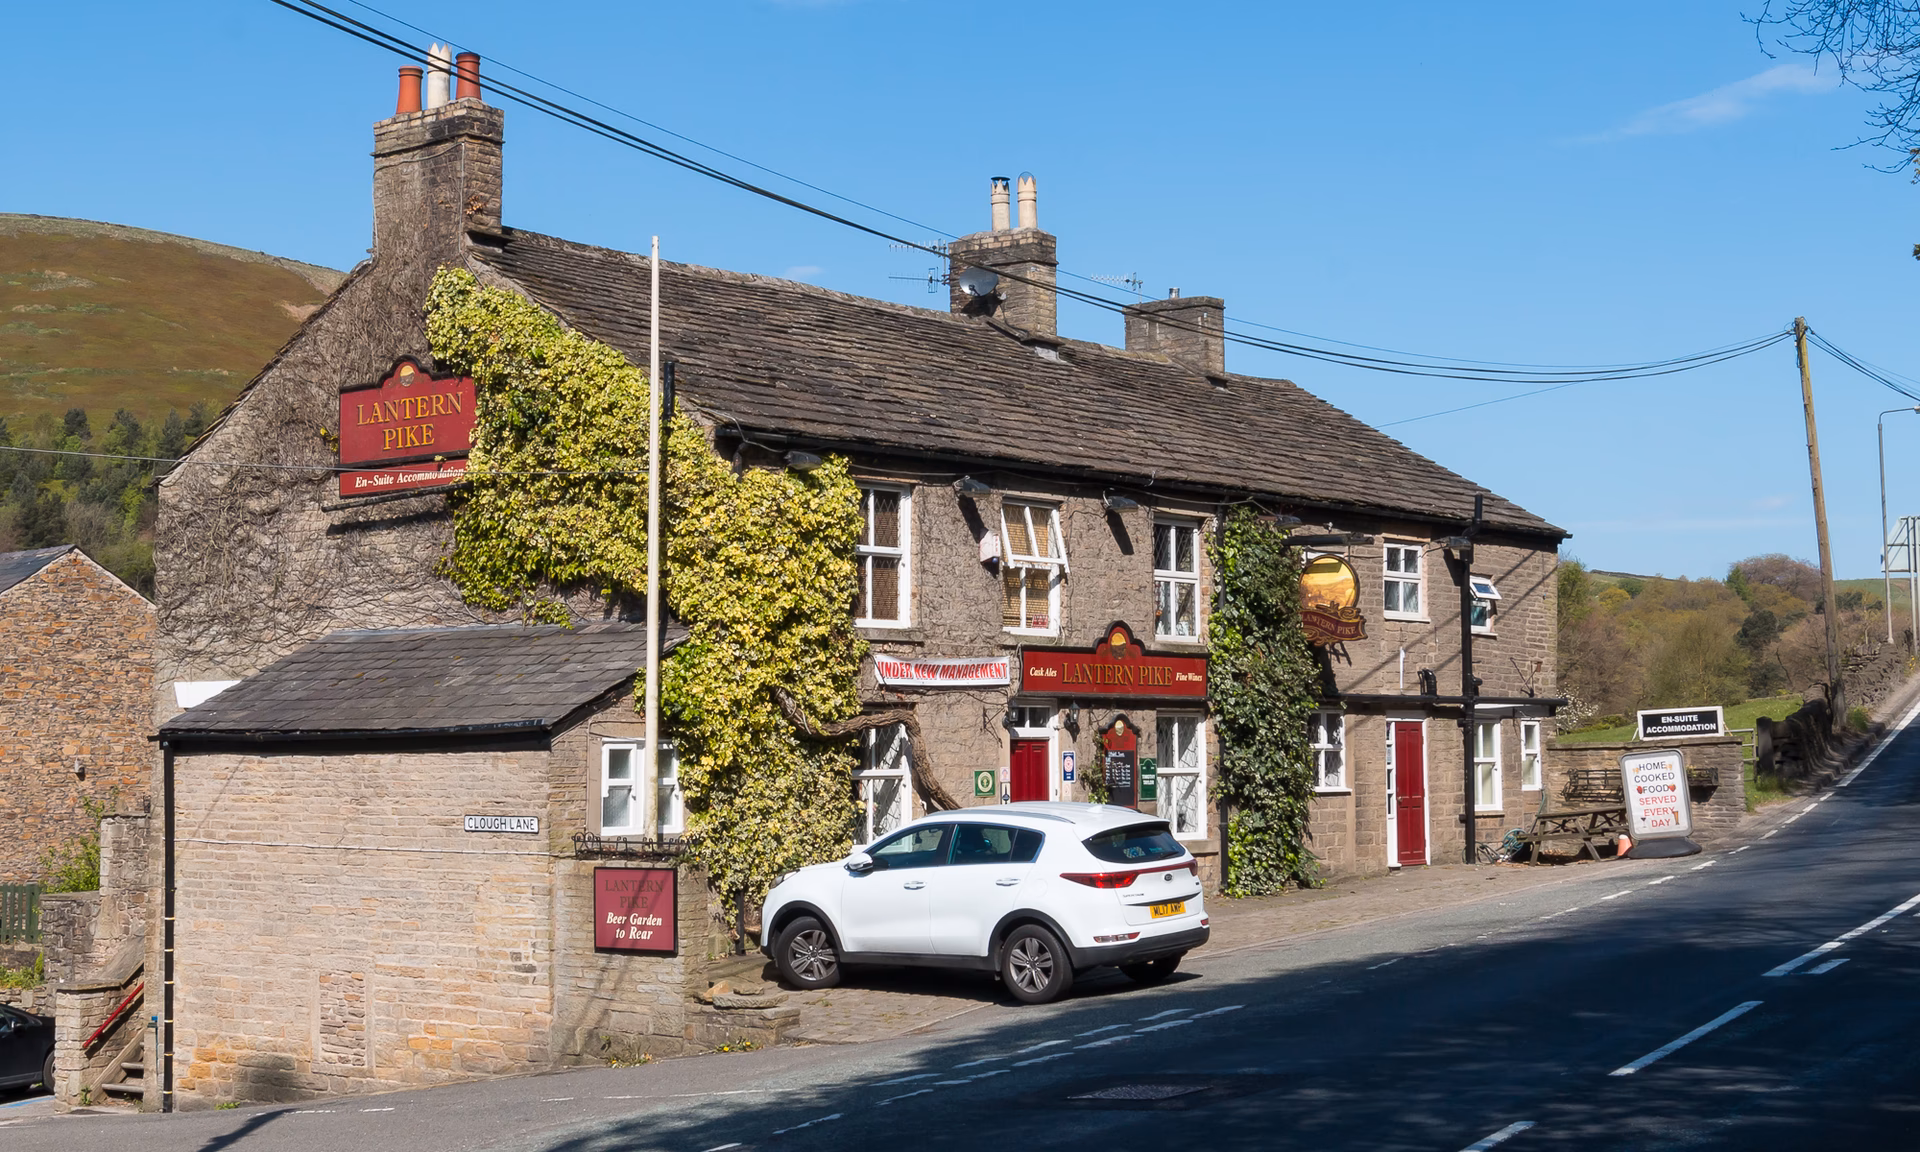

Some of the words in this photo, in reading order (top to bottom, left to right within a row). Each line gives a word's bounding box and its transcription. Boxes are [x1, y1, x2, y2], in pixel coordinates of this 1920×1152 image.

[357, 392, 463, 425] LANTERN
[383, 424, 435, 450] PIKE
[354, 473, 394, 488] En-Suite
[1302, 614, 1335, 630] LANTERN
[1337, 626, 1356, 635] PIKE
[877, 661, 914, 680] UNDER
[914, 663, 940, 680] NEW
[939, 662, 1008, 680] MANAGEMENT
[1029, 667, 1044, 677] Cask
[1044, 667, 1058, 678] Ales
[1062, 662, 1135, 686] LANTERN
[1138, 665, 1173, 687] PIKE
[1176, 672, 1188, 682] Fine
[1188, 672, 1203, 683] Wines
[1661, 715, 1698, 724] EN-SUITE
[1646, 723, 1717, 733] ACCOMMODATION
[1638, 761, 1667, 771] HOME
[1634, 772, 1675, 783] COOKED
[1642, 783, 1670, 794] FOOD
[1639, 795, 1677, 806] SERVED
[1643, 806, 1676, 817] EVERY
[467, 816, 507, 830] CLOUGH
[509, 817, 536, 831] LANE
[1651, 818, 1671, 828] DAY
[604, 879, 664, 893] LANTERN
[619, 895, 649, 909] PIKE
[606, 911, 627, 925] Beer
[629, 912, 663, 927] Garden
[615, 927, 626, 939] to
[628, 926, 654, 940] Rear
